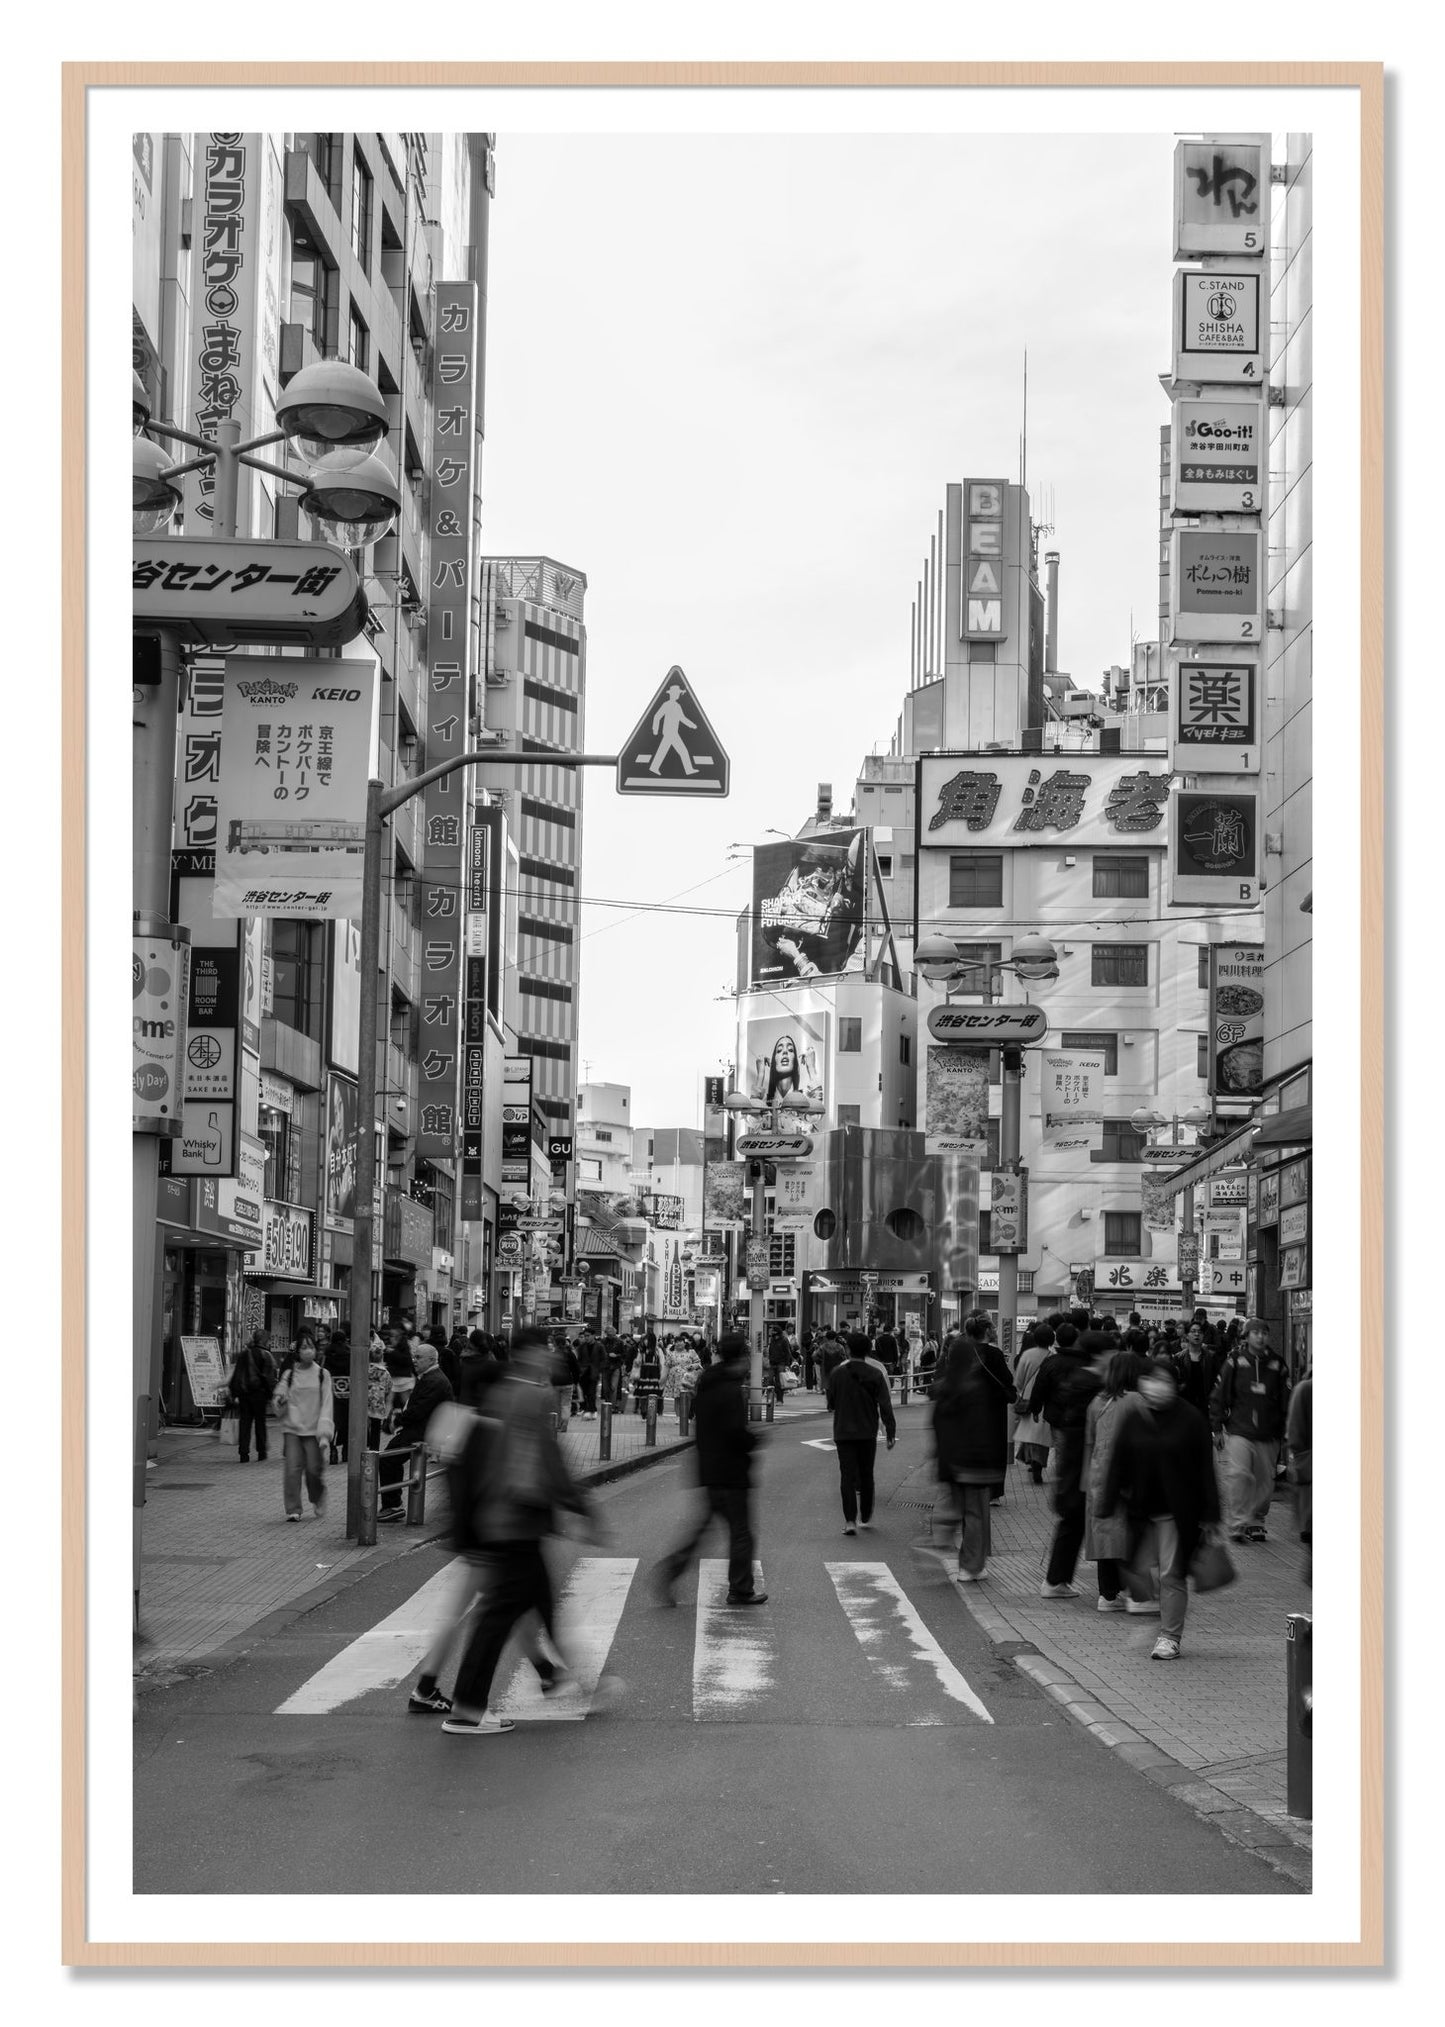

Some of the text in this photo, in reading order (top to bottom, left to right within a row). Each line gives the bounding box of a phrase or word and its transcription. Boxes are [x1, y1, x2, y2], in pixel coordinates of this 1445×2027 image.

[203, 146, 246, 289] カラオケ
[1244, 232, 1257, 248] 5
[1198, 280, 1245, 291] C.STAND
[1198, 322, 1244, 333] SHISHA
[1198, 334, 1244, 342] CAFE&BAR
[1243, 361, 1255, 377] 4
[1197, 422, 1253, 438] Goo-it!
[1190, 442, 1250, 452] 渋谷宇田川町店
[1184, 468, 1254, 480] 全身もみほぐし
[1241, 491, 1254, 508] 3
[969, 483, 1002, 632] BEAM
[1185, 563, 1252, 584] ポムの樹
[1196, 588, 1243, 596] Pomme-no-ki
[1241, 621, 1253, 637] 2
[250, 696, 286, 704] KANTO
[311, 687, 361, 701] KEIO
[1189, 671, 1241, 723] 薬
[1183, 725, 1246, 741] マツモトキヨシ
[254, 724, 271, 768] 冒険へ
[273, 724, 292, 801] カントーの
[294, 724, 313, 801] ポケパーク
[317, 725, 334, 786] 京王線で
[1240, 753, 1250, 769] 1
[928, 769, 1172, 832] 角海老
[473, 830, 481, 908] kimono hearts
[242, 890, 333, 905] 渋谷センター街
[1239, 883, 1251, 900] B
[195, 967, 218, 976] THIRD
[200, 960, 215, 968] THE
[195, 996, 217, 1005] ROOM
[198, 1007, 214, 1016] BAR
[935, 1014, 1040, 1028] 渋谷センター街
[1216, 1023, 1246, 1043] 6F
[147, 1073, 167, 1092] Day!
[183, 1139, 217, 1150] Whisky
[550, 1142, 571, 1154] GU
[739, 1139, 803, 1150] 渋谷センター街
[182, 1149, 203, 1158] Bank
[1109, 1264, 1169, 1287] 兆楽
[671, 1263, 681, 1307] BEER
[669, 1308, 682, 1316] HALL
